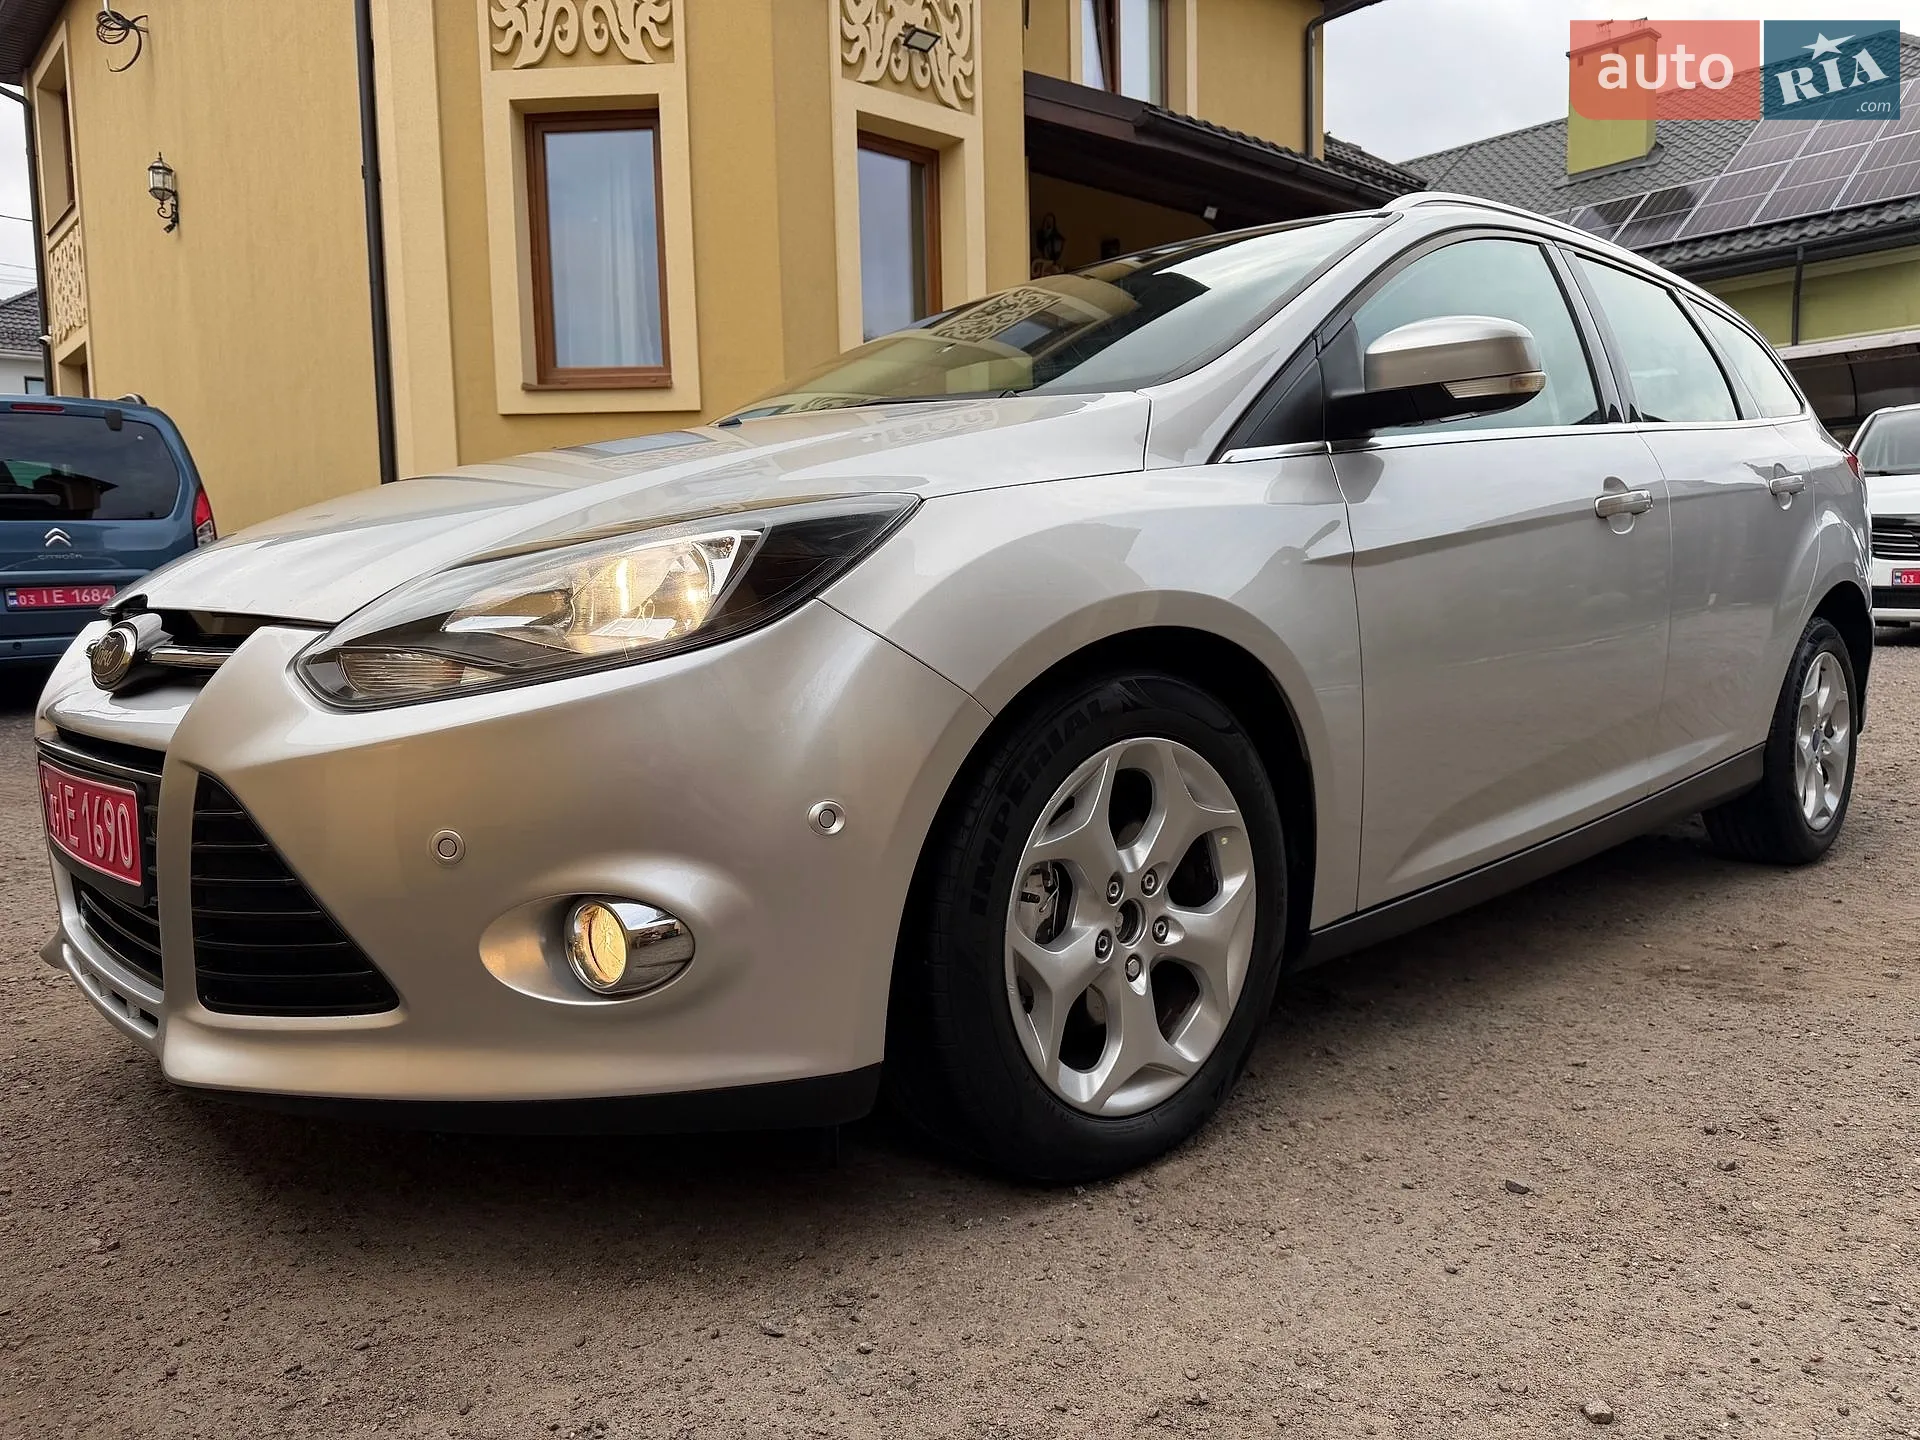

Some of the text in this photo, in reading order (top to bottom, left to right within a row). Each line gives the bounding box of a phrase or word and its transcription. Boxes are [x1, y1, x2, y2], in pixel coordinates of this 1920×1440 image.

[71, 587, 112, 604] 1684
[81, 791, 133, 870] 1690
[969, 698, 1104, 916] IMPERIAL
